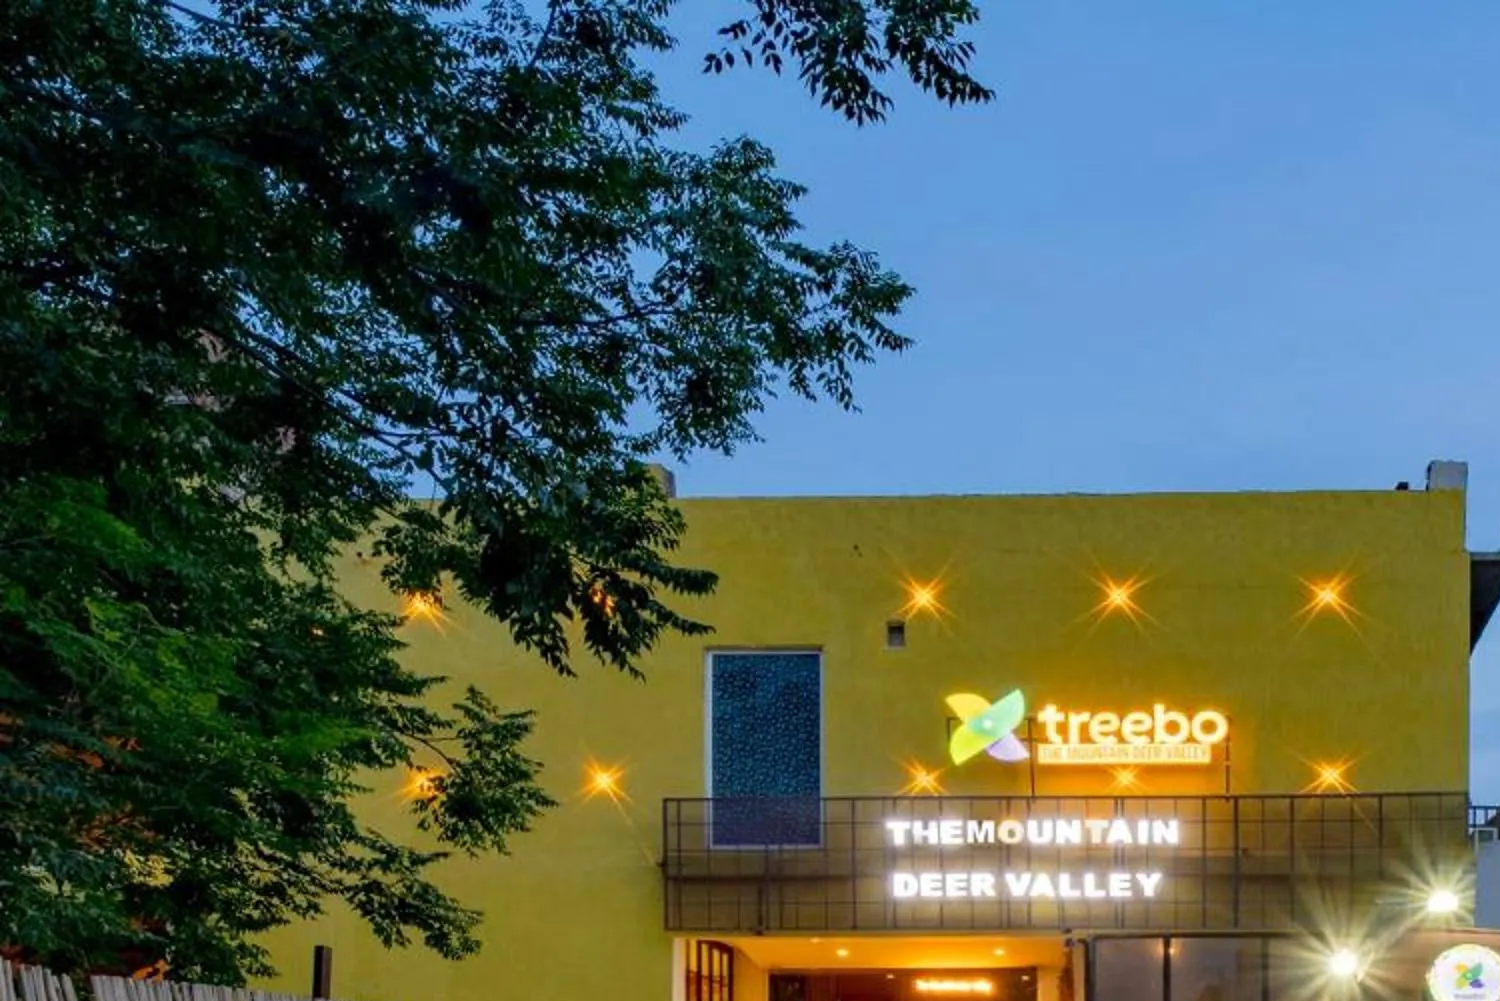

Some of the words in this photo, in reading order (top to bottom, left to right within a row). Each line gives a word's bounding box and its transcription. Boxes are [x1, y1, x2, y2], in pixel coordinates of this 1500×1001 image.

[1038, 704, 1228, 744] treebo
[893, 872, 996, 897] DEER
[1005, 872, 1162, 897] VALLEY
